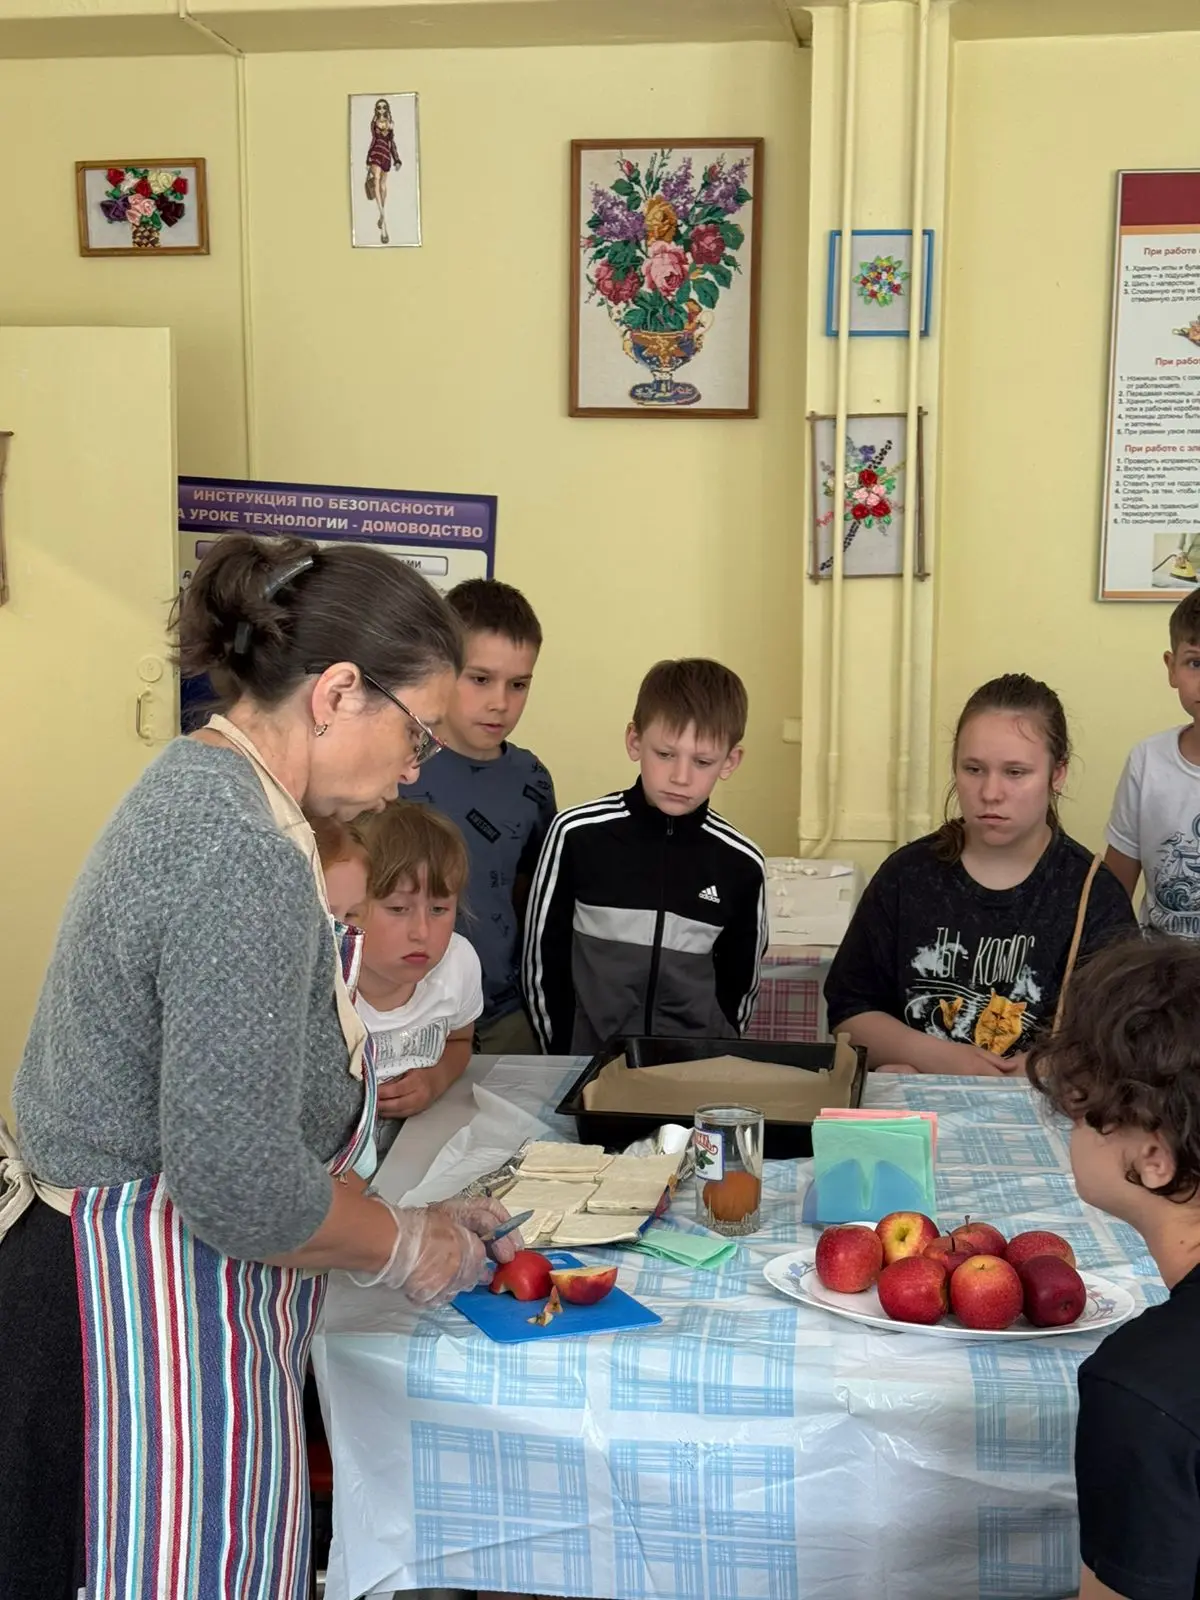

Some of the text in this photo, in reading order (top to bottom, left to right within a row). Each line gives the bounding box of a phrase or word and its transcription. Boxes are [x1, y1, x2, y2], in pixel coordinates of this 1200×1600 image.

[1144, 247, 1196, 257] При работе
[1155, 358, 1173, 366] При
[1125, 445, 1143, 453] При
[1145, 444, 1177, 453] работе
[193, 489, 455, 517] ИНСТРУКЦИЯ ПО БЕЗОПАСНОСТИ
[190, 508, 239, 523] УРОКЕ
[243, 512, 348, 530] ТЕХНОЛОГИИ
[361, 519, 483, 538] ДОМОВОДСТВО
